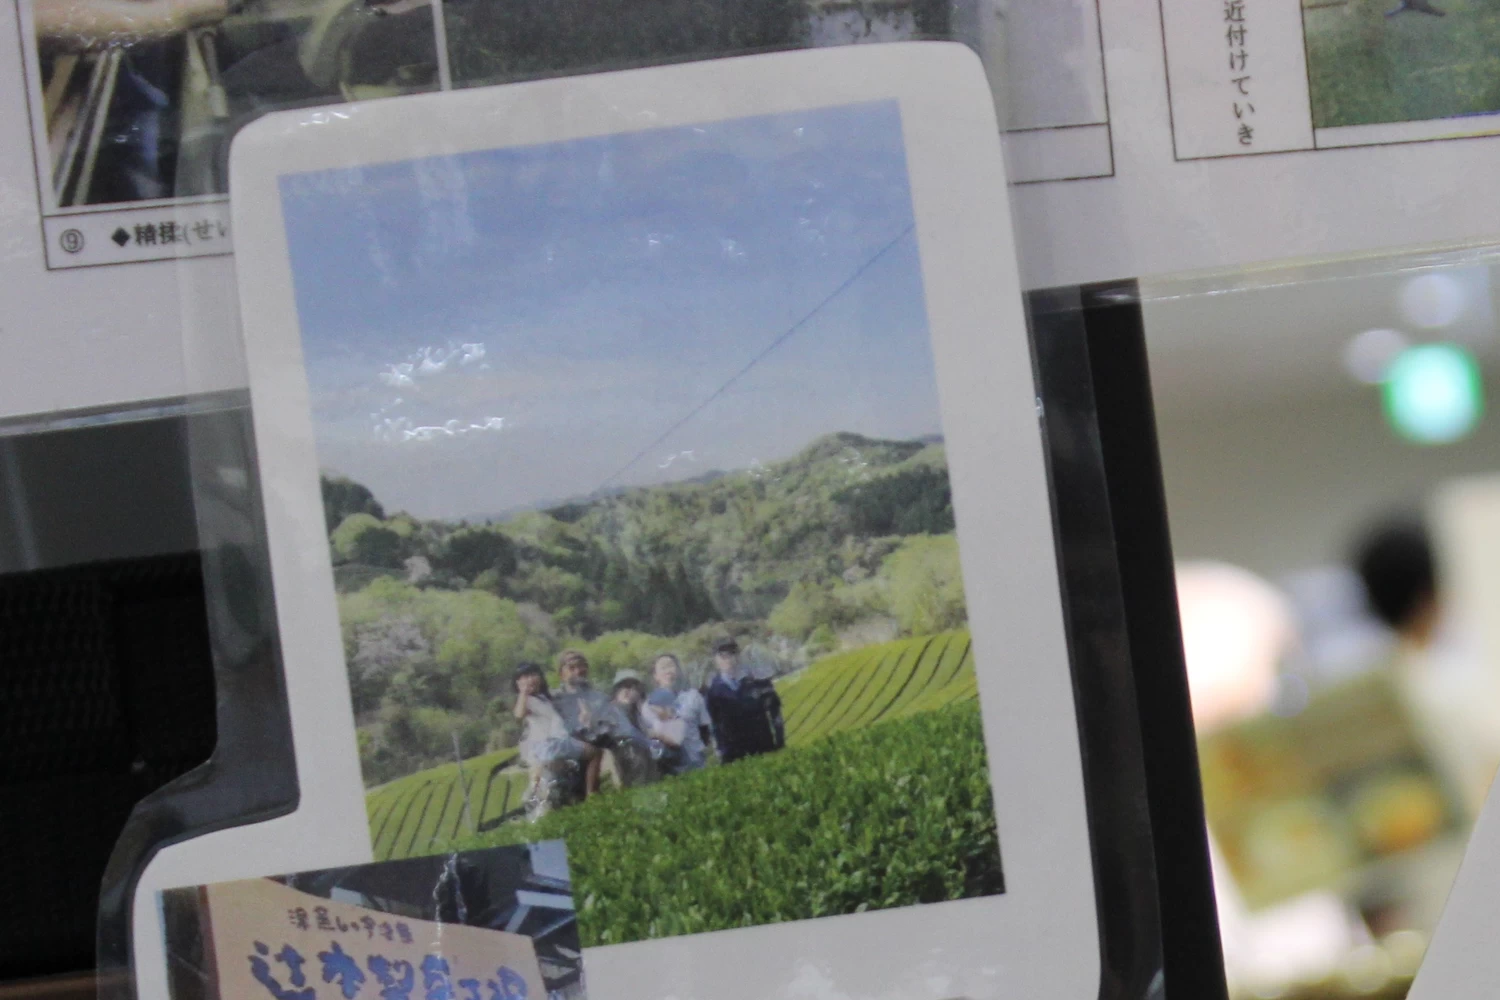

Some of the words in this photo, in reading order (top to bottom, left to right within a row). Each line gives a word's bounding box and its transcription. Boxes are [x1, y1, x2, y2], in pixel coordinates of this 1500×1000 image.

[1224, 0, 1255, 146] 近付けていき
